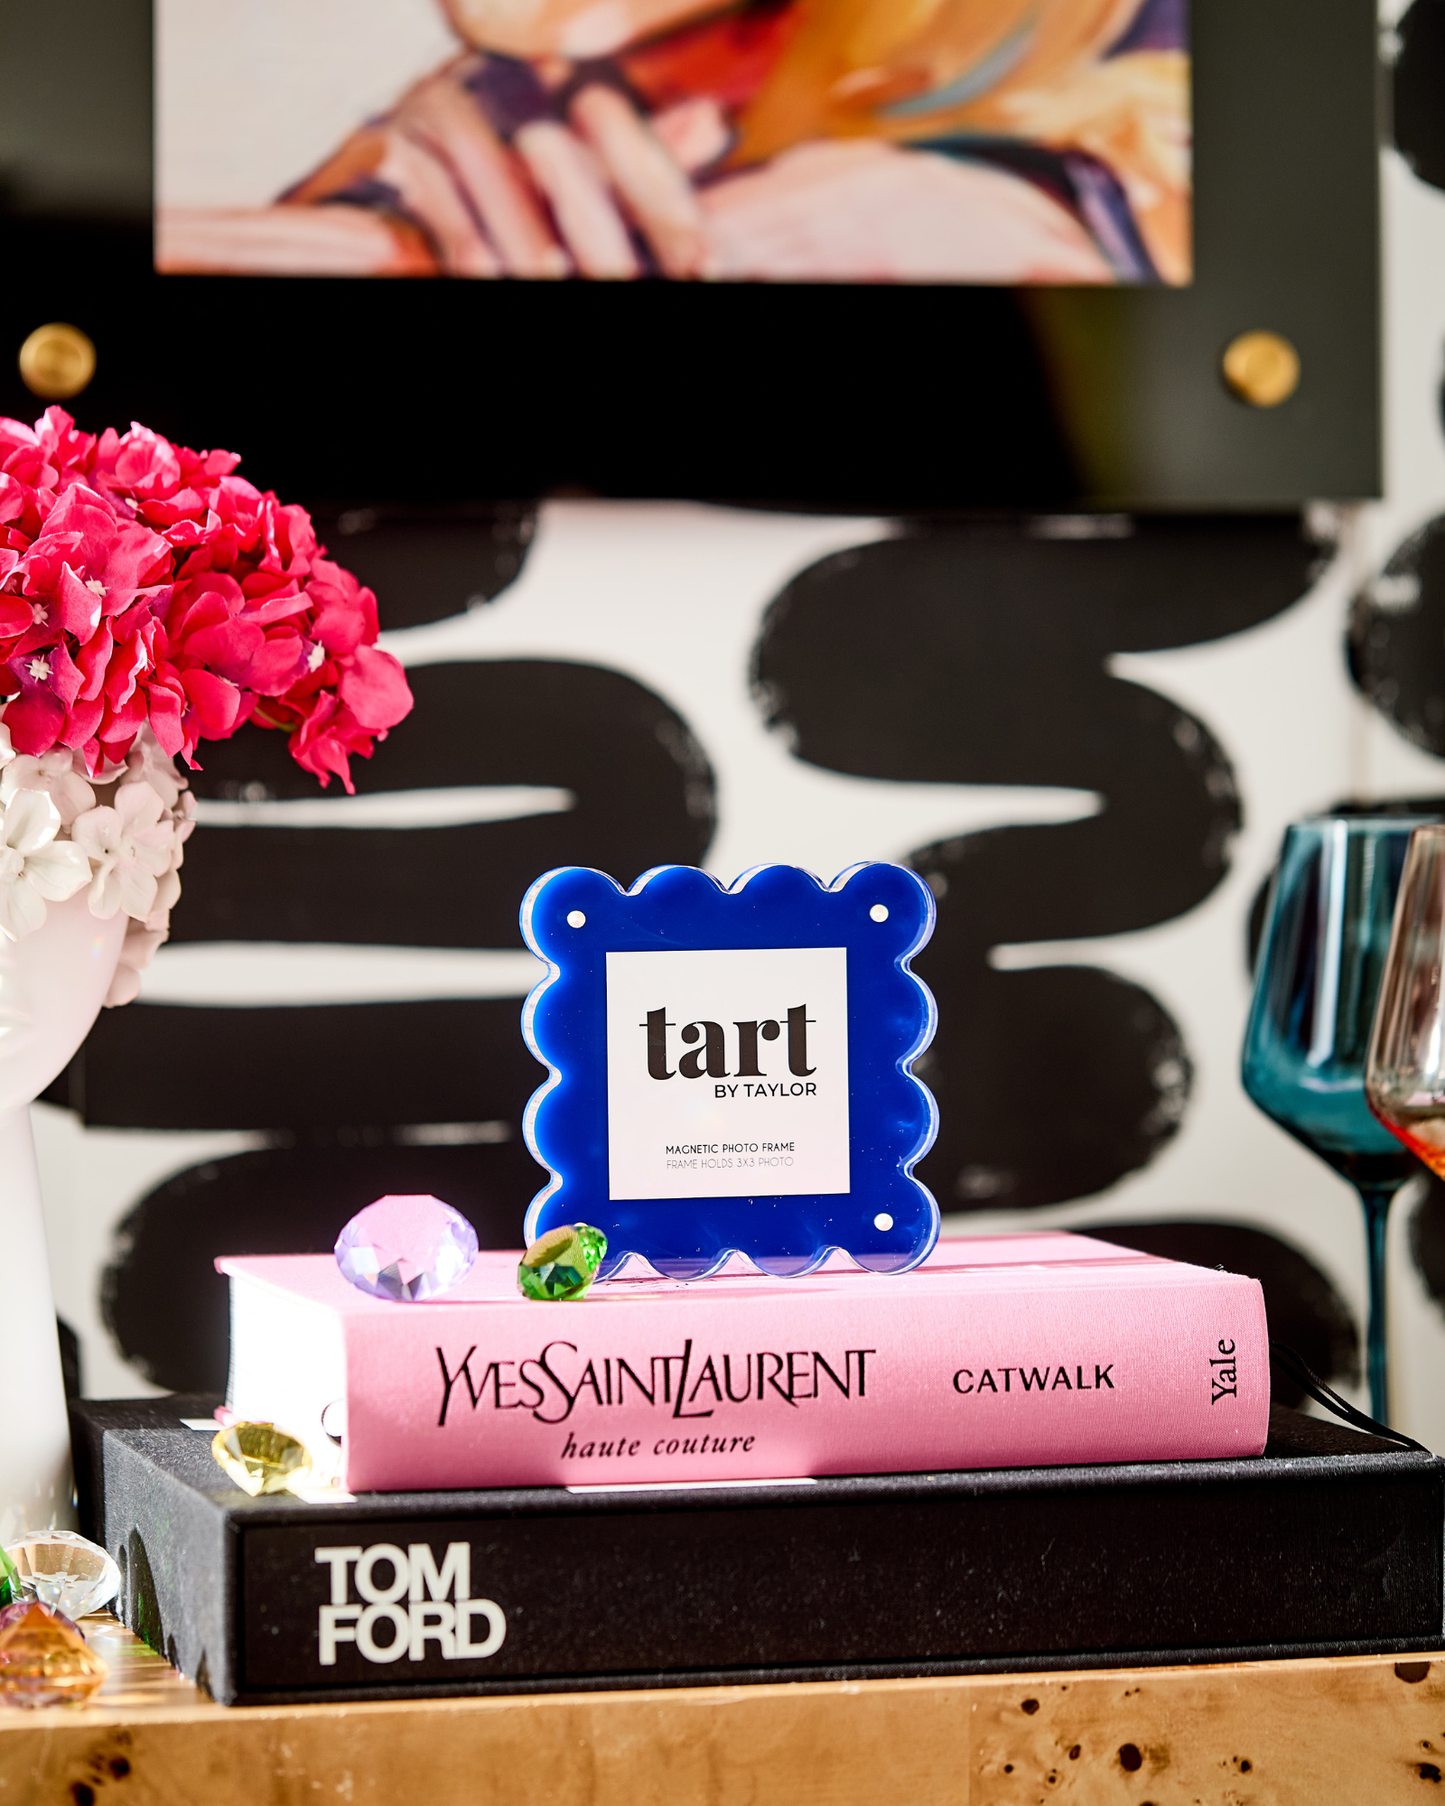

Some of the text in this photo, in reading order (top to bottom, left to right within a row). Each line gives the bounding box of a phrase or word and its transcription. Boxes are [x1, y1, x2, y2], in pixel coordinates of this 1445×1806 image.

[639, 1004, 817, 1080] tart
[715, 1082, 817, 1098] BY TAYLOR
[666, 1142, 795, 1154] MAGNETIC PHOTO FRAME
[666, 1156, 794, 1169] FRAME HOLDS 3X3 PHOTO
[953, 1364, 1115, 1394] CATWALK
[1209, 1338, 1237, 1405] Yale
[561, 1432, 755, 1459] haute couture
[314, 1541, 471, 1605] TOM
[318, 1598, 507, 1666] FORD
